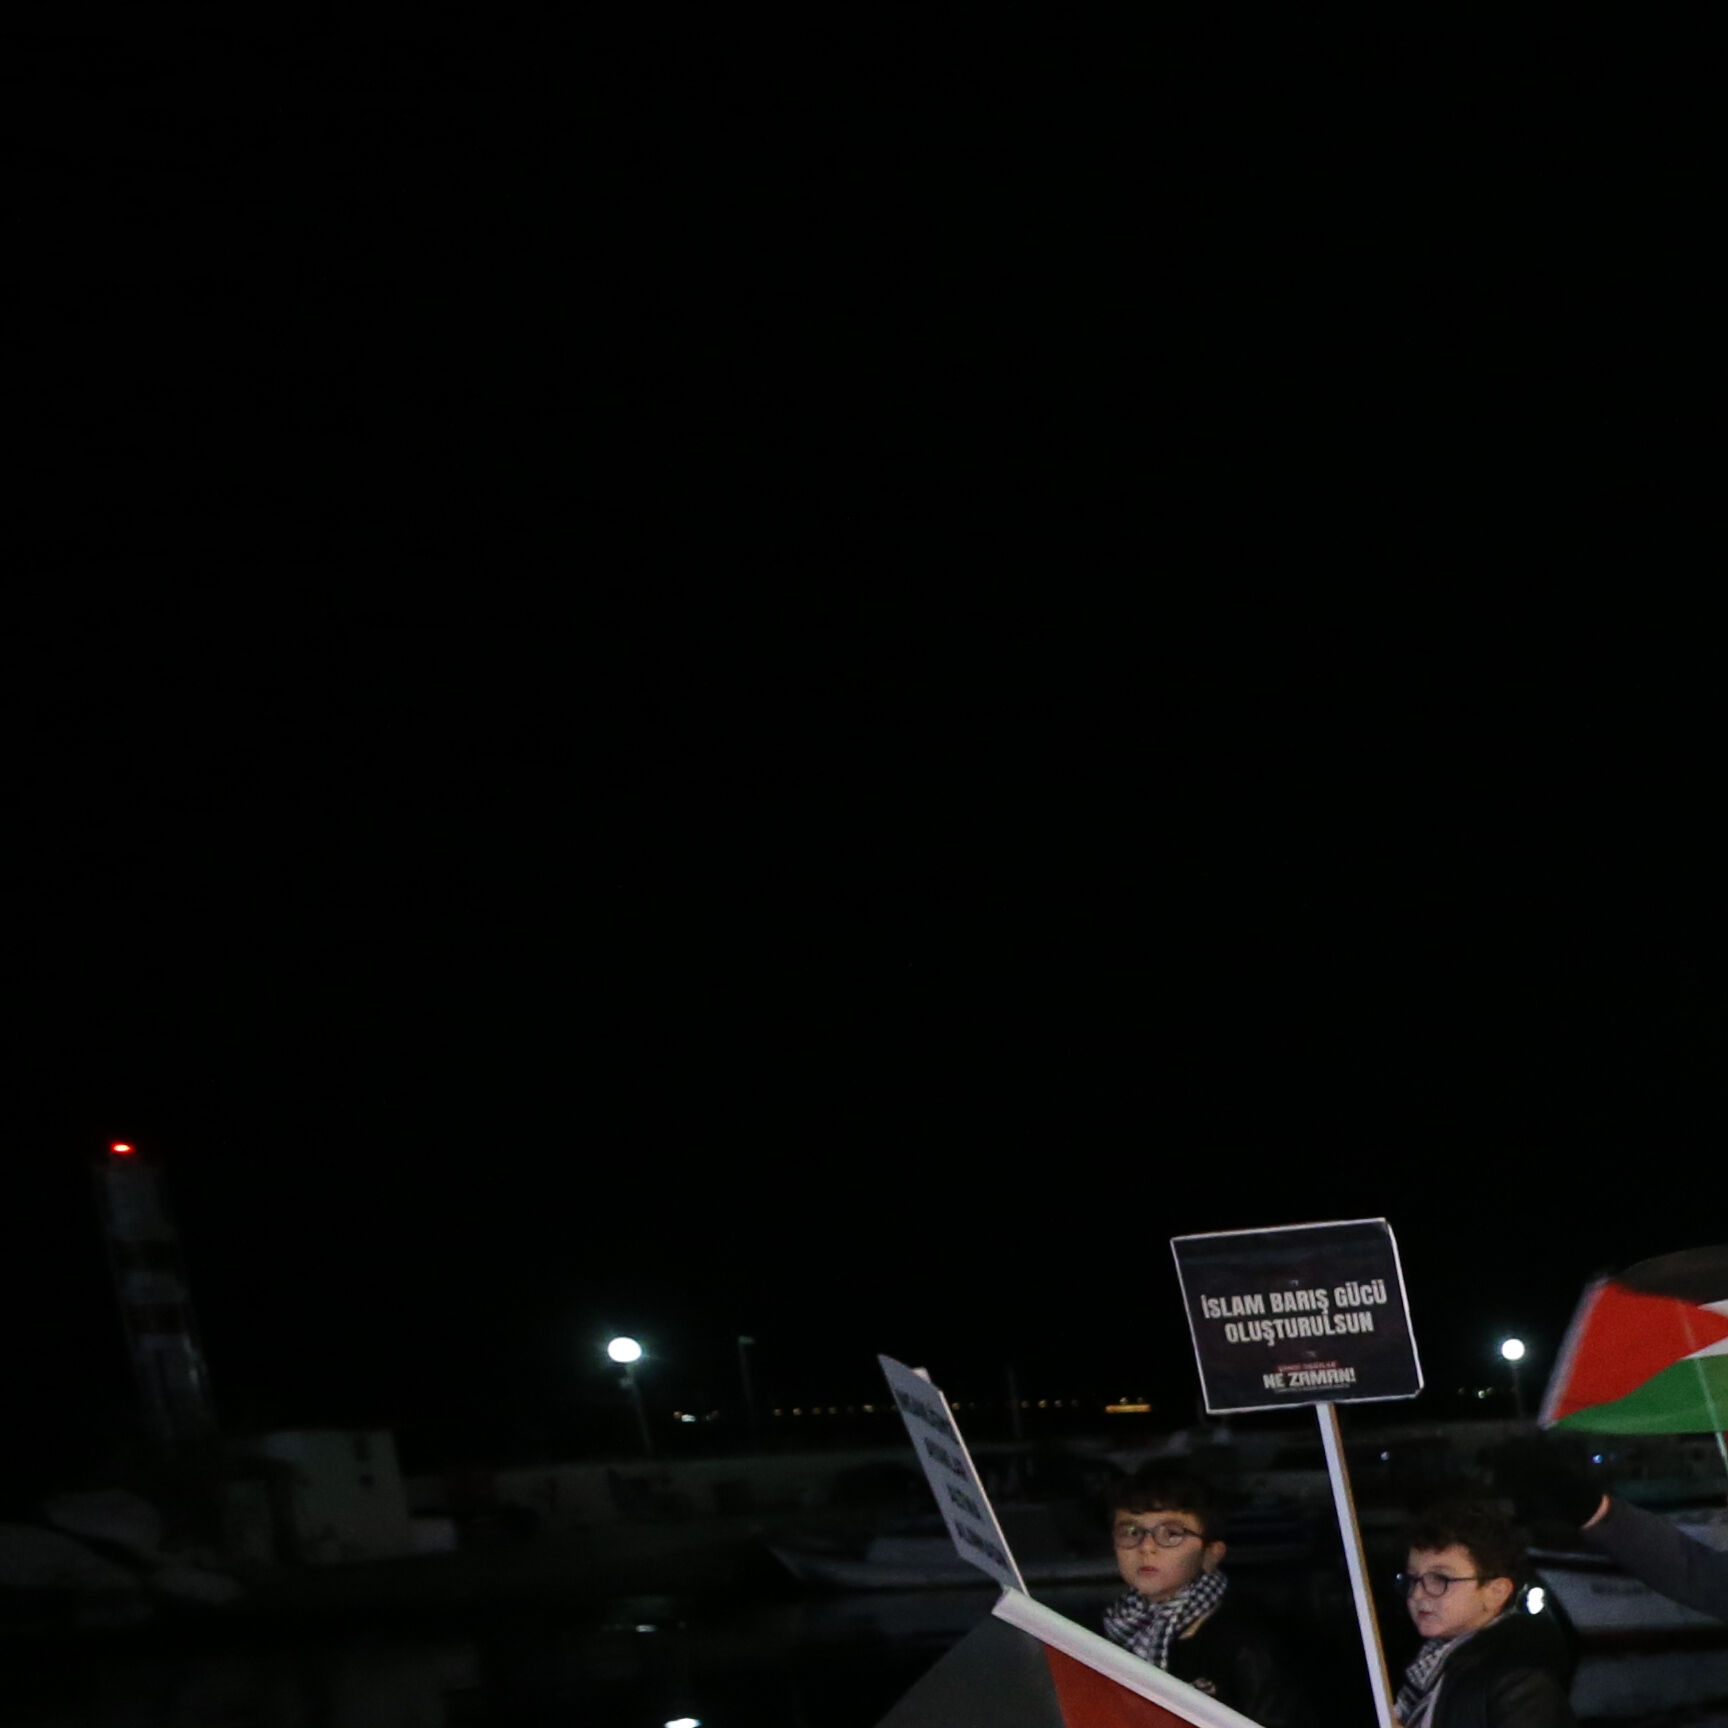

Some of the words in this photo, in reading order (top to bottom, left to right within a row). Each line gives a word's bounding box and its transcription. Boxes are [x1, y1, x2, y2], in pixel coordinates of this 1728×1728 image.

[1201, 1294, 1265, 1319] İSLAM
[1269, 1289, 1329, 1315] BARIŞ
[1334, 1279, 1388, 1308] GÜCÜ
[1224, 1311, 1374, 1346] OLUŞTURULSUN
[1263, 1372, 1286, 1389] NE
[1290, 1367, 1356, 1387] ZAMAN!
